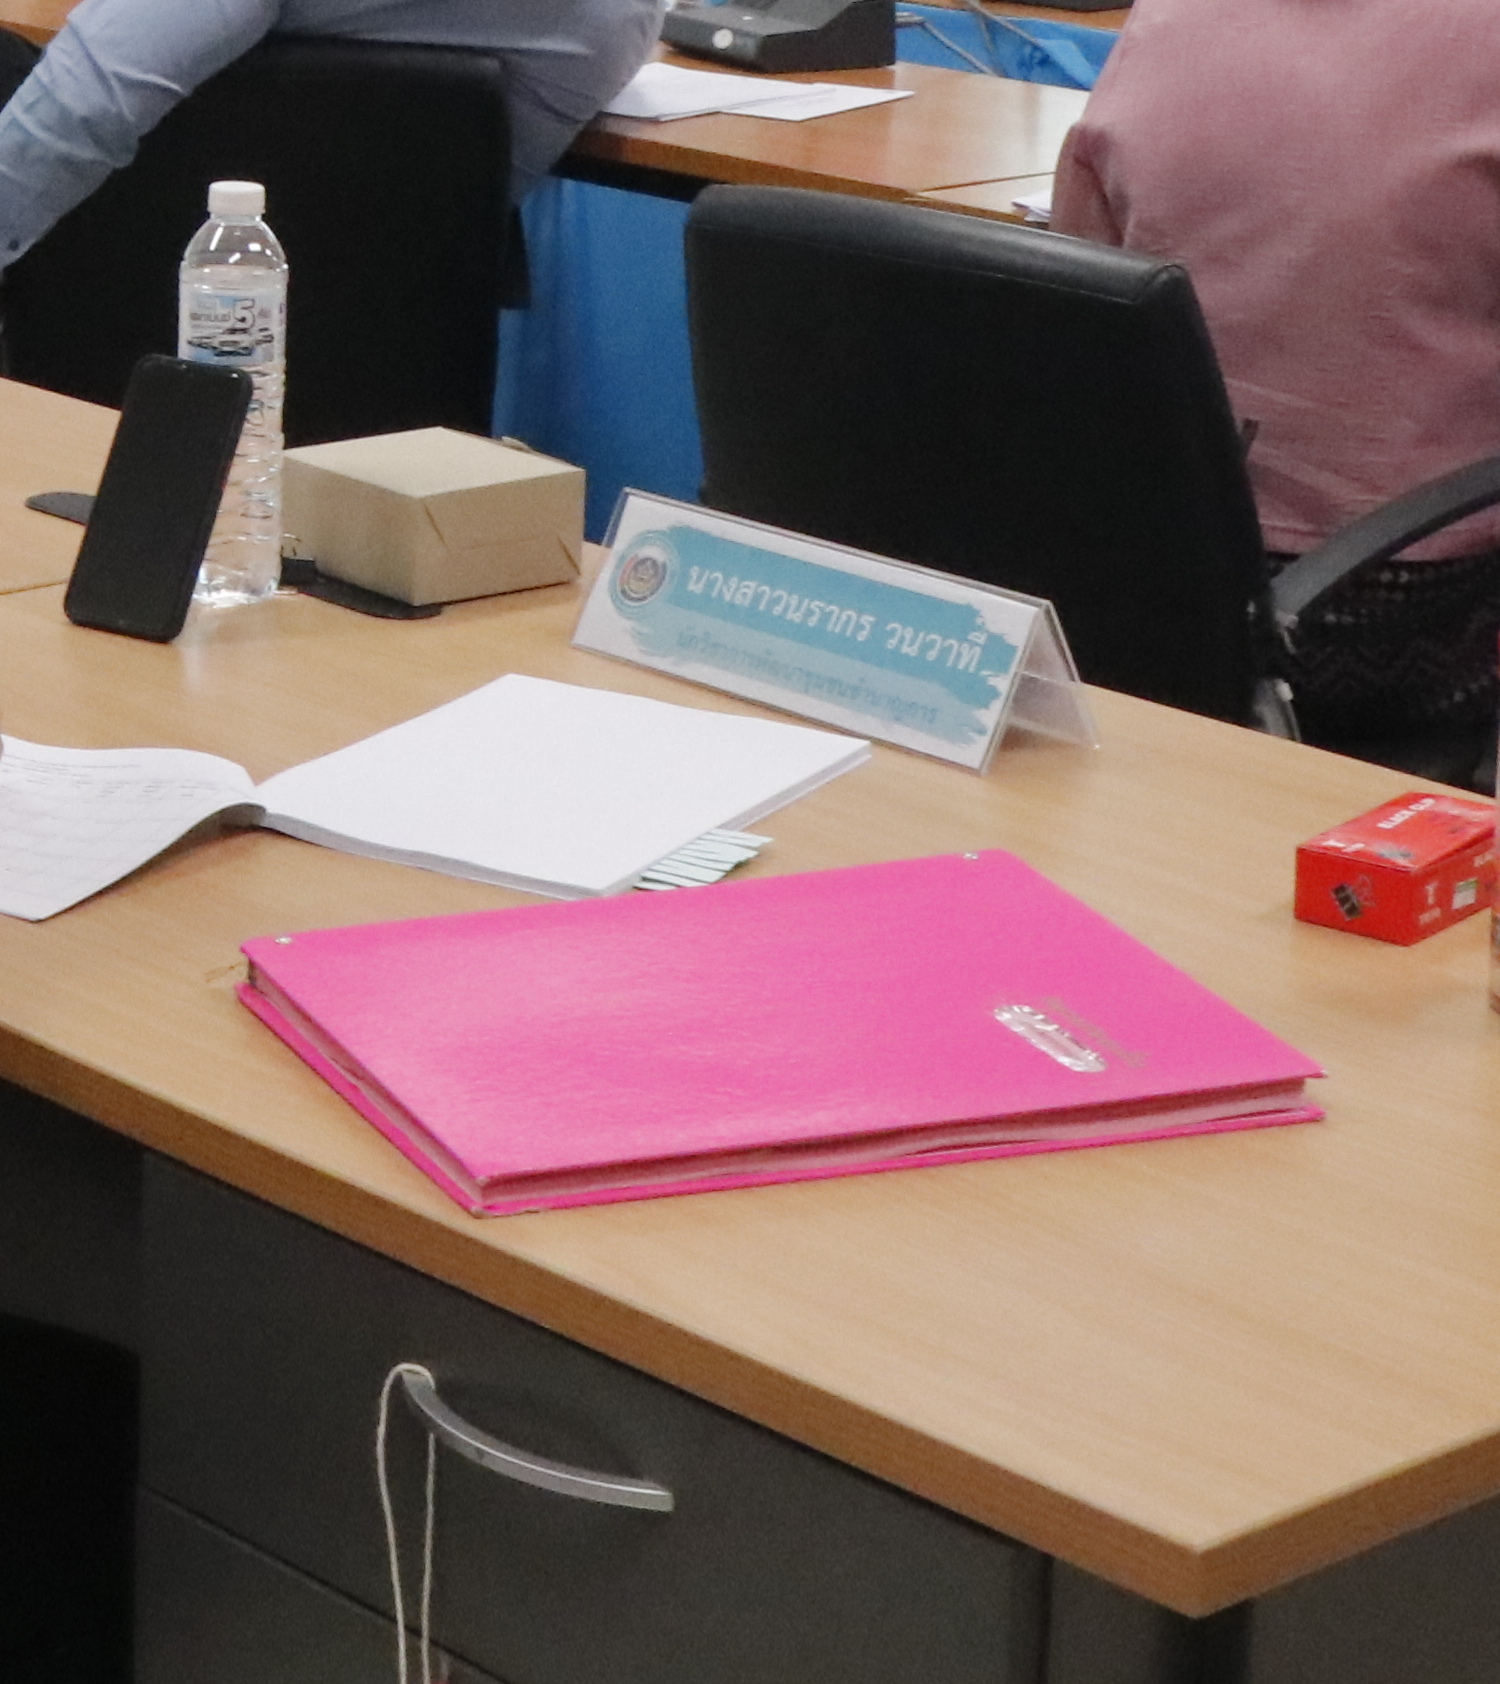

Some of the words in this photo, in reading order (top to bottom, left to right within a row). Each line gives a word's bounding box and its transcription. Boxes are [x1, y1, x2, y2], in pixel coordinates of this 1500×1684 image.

[686, 564, 877, 642] นางสาวนรากร
